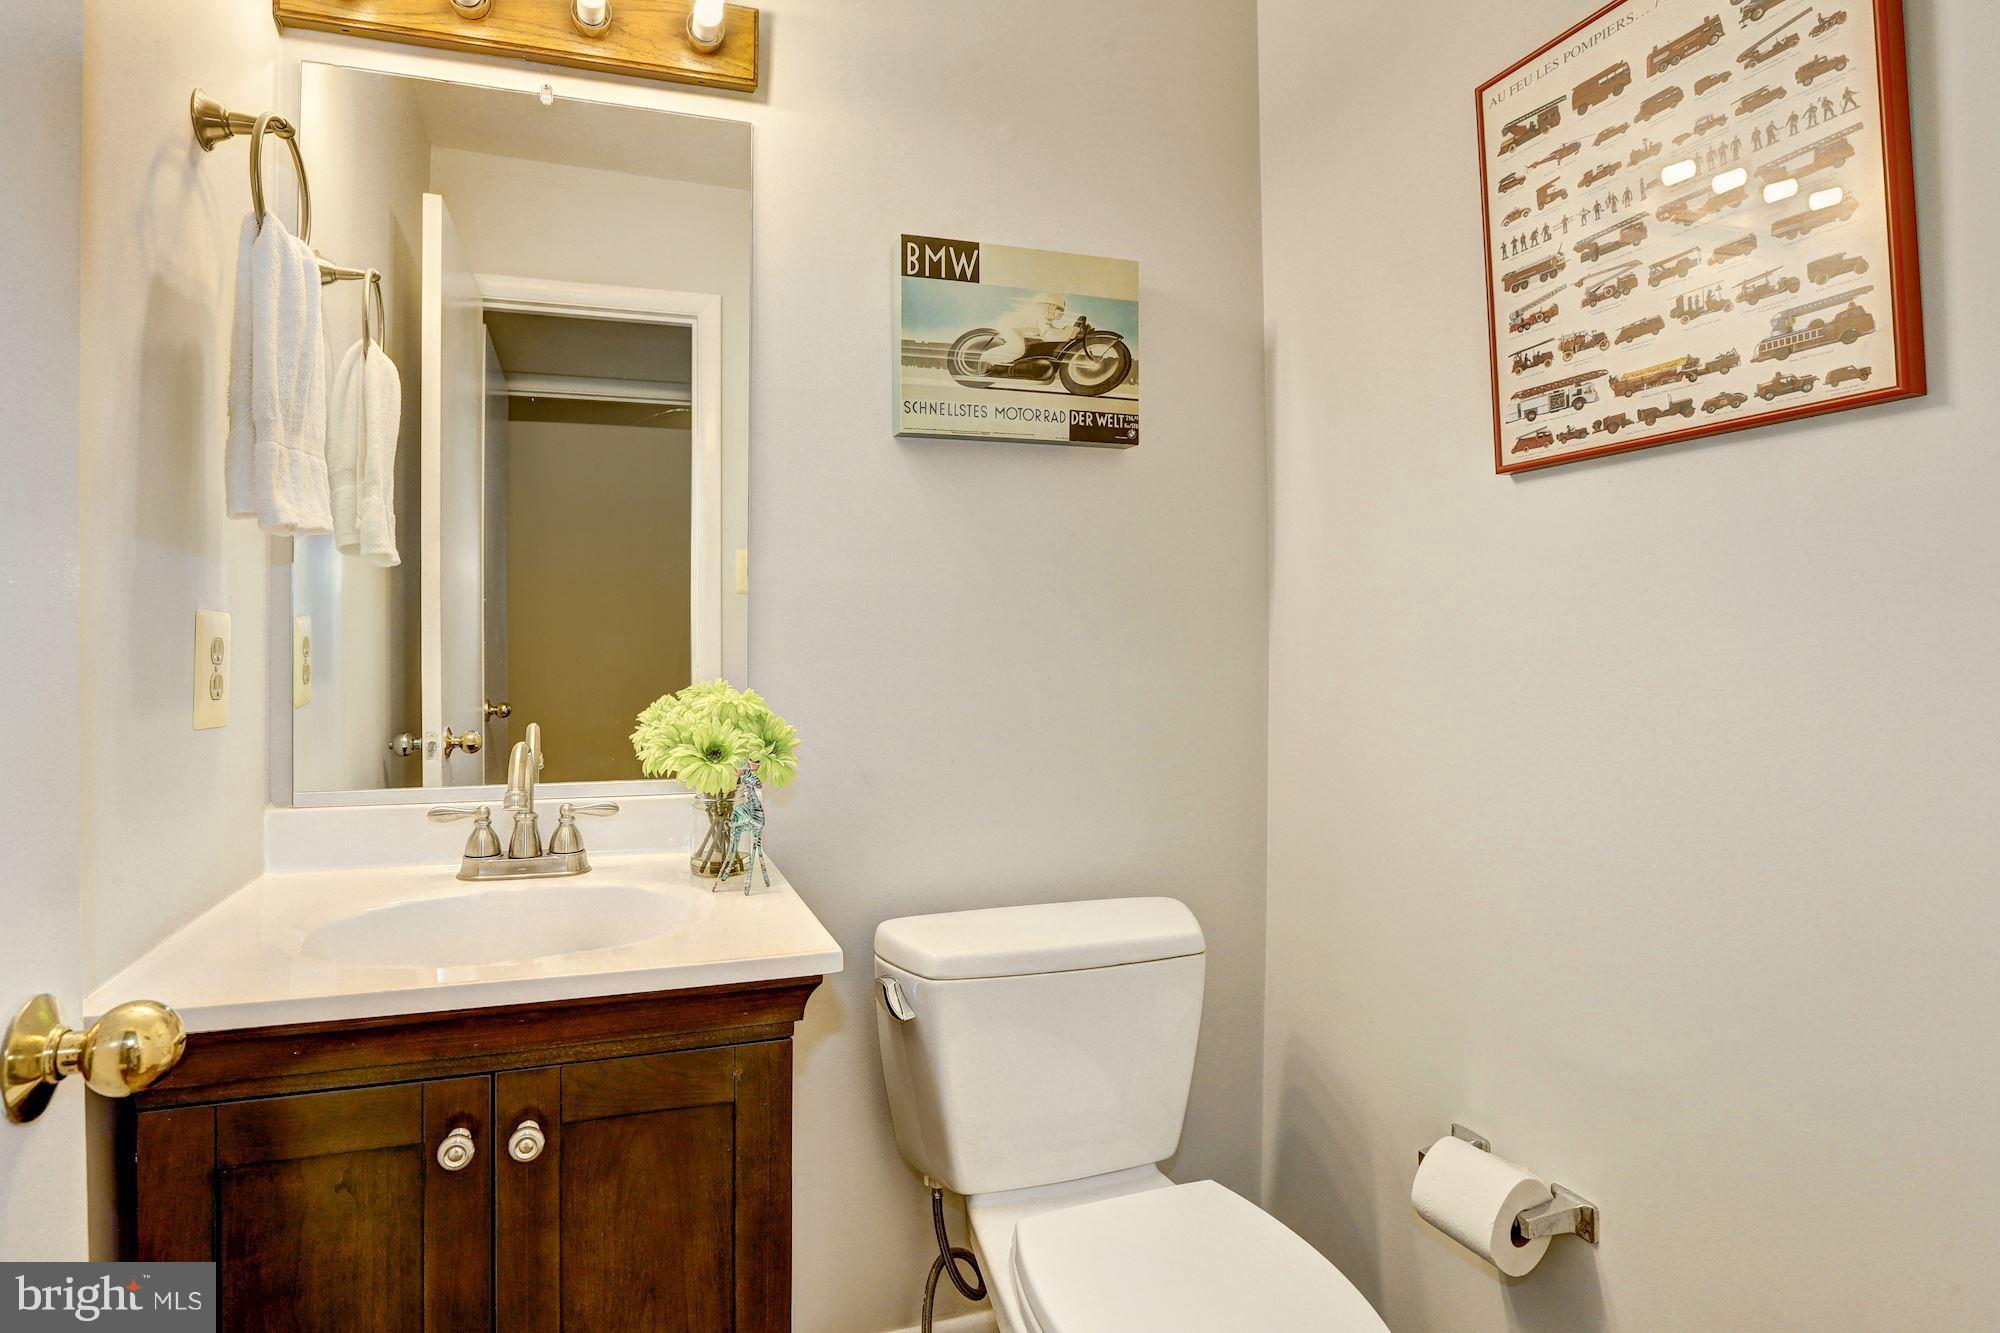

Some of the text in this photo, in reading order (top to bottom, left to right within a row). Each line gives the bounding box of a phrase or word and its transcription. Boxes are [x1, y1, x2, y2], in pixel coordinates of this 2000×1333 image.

[1489, 89, 1506, 109] AU
[1508, 73, 1534, 97] FEU
[1536, 57, 1560, 80] LES
[906, 242, 979, 281] BMW
[903, 400, 988, 418] SCHNELLSTES
[994, 406, 1067, 424] MOTORRAD
[1071, 410, 1094, 427] DER
[1095, 412, 1125, 429] WELT
